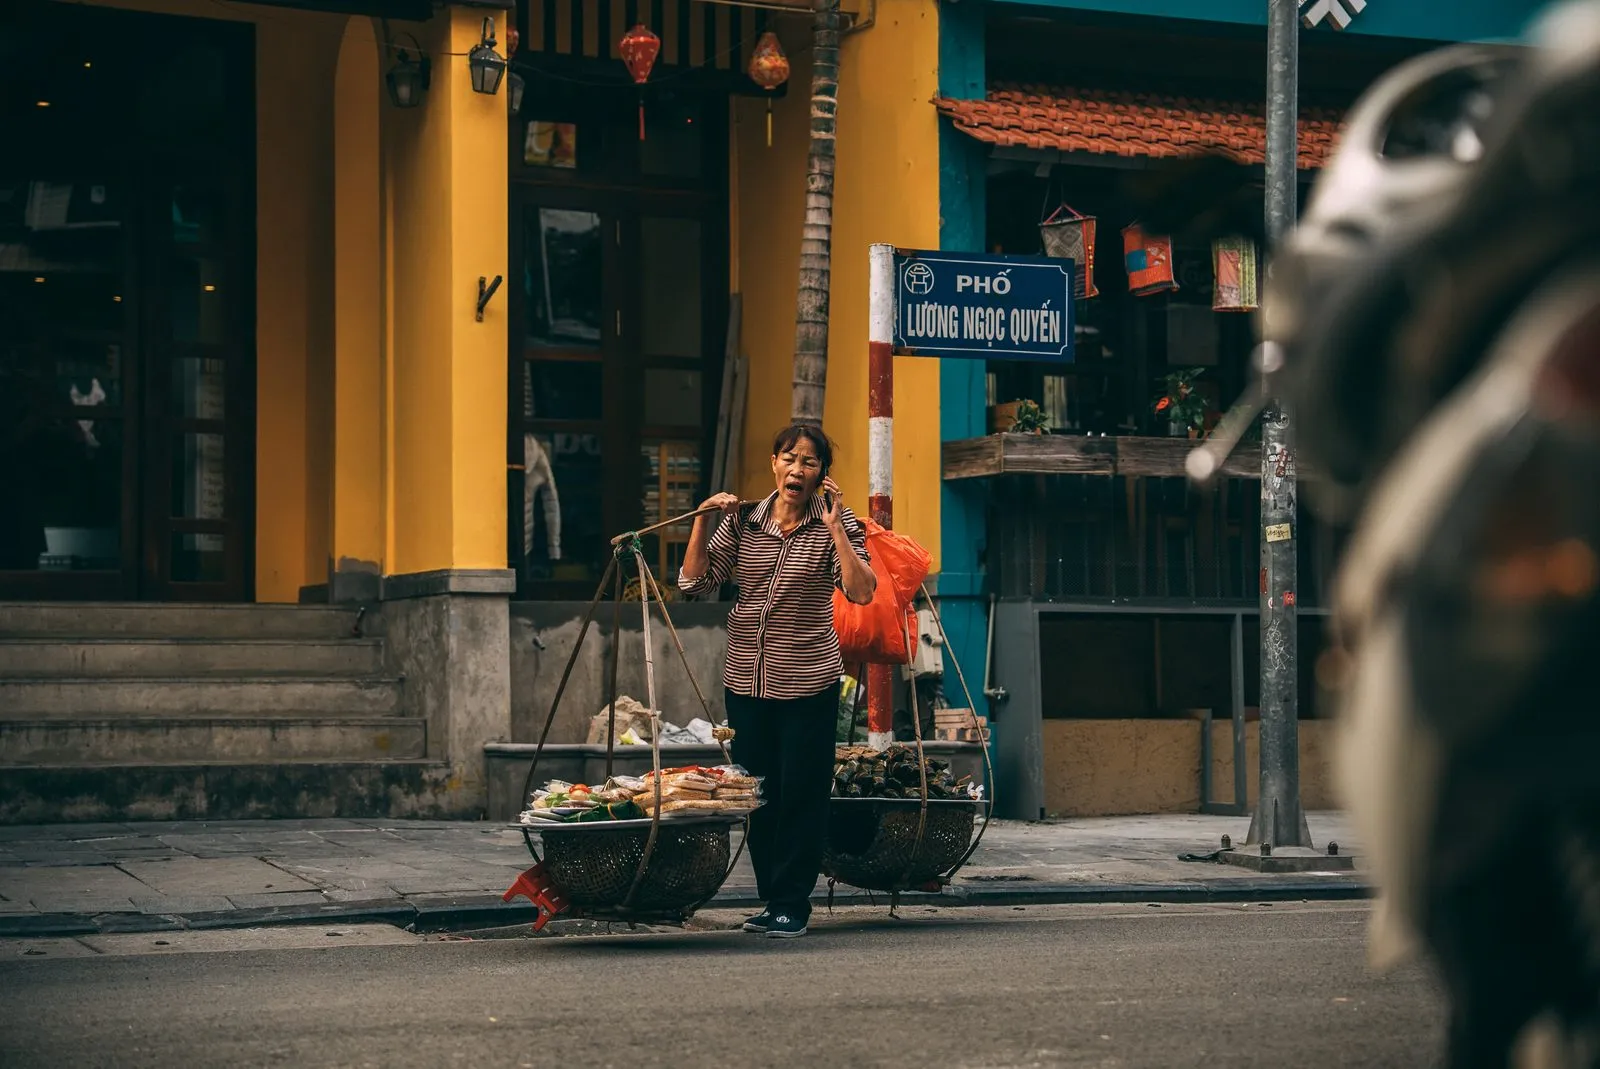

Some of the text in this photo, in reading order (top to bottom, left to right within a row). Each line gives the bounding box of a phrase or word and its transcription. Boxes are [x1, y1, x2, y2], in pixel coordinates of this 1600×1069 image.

[956, 269, 1012, 294] PHỐ
[907, 299, 1061, 347] LƯƠNG NGỌC QUYẾN
